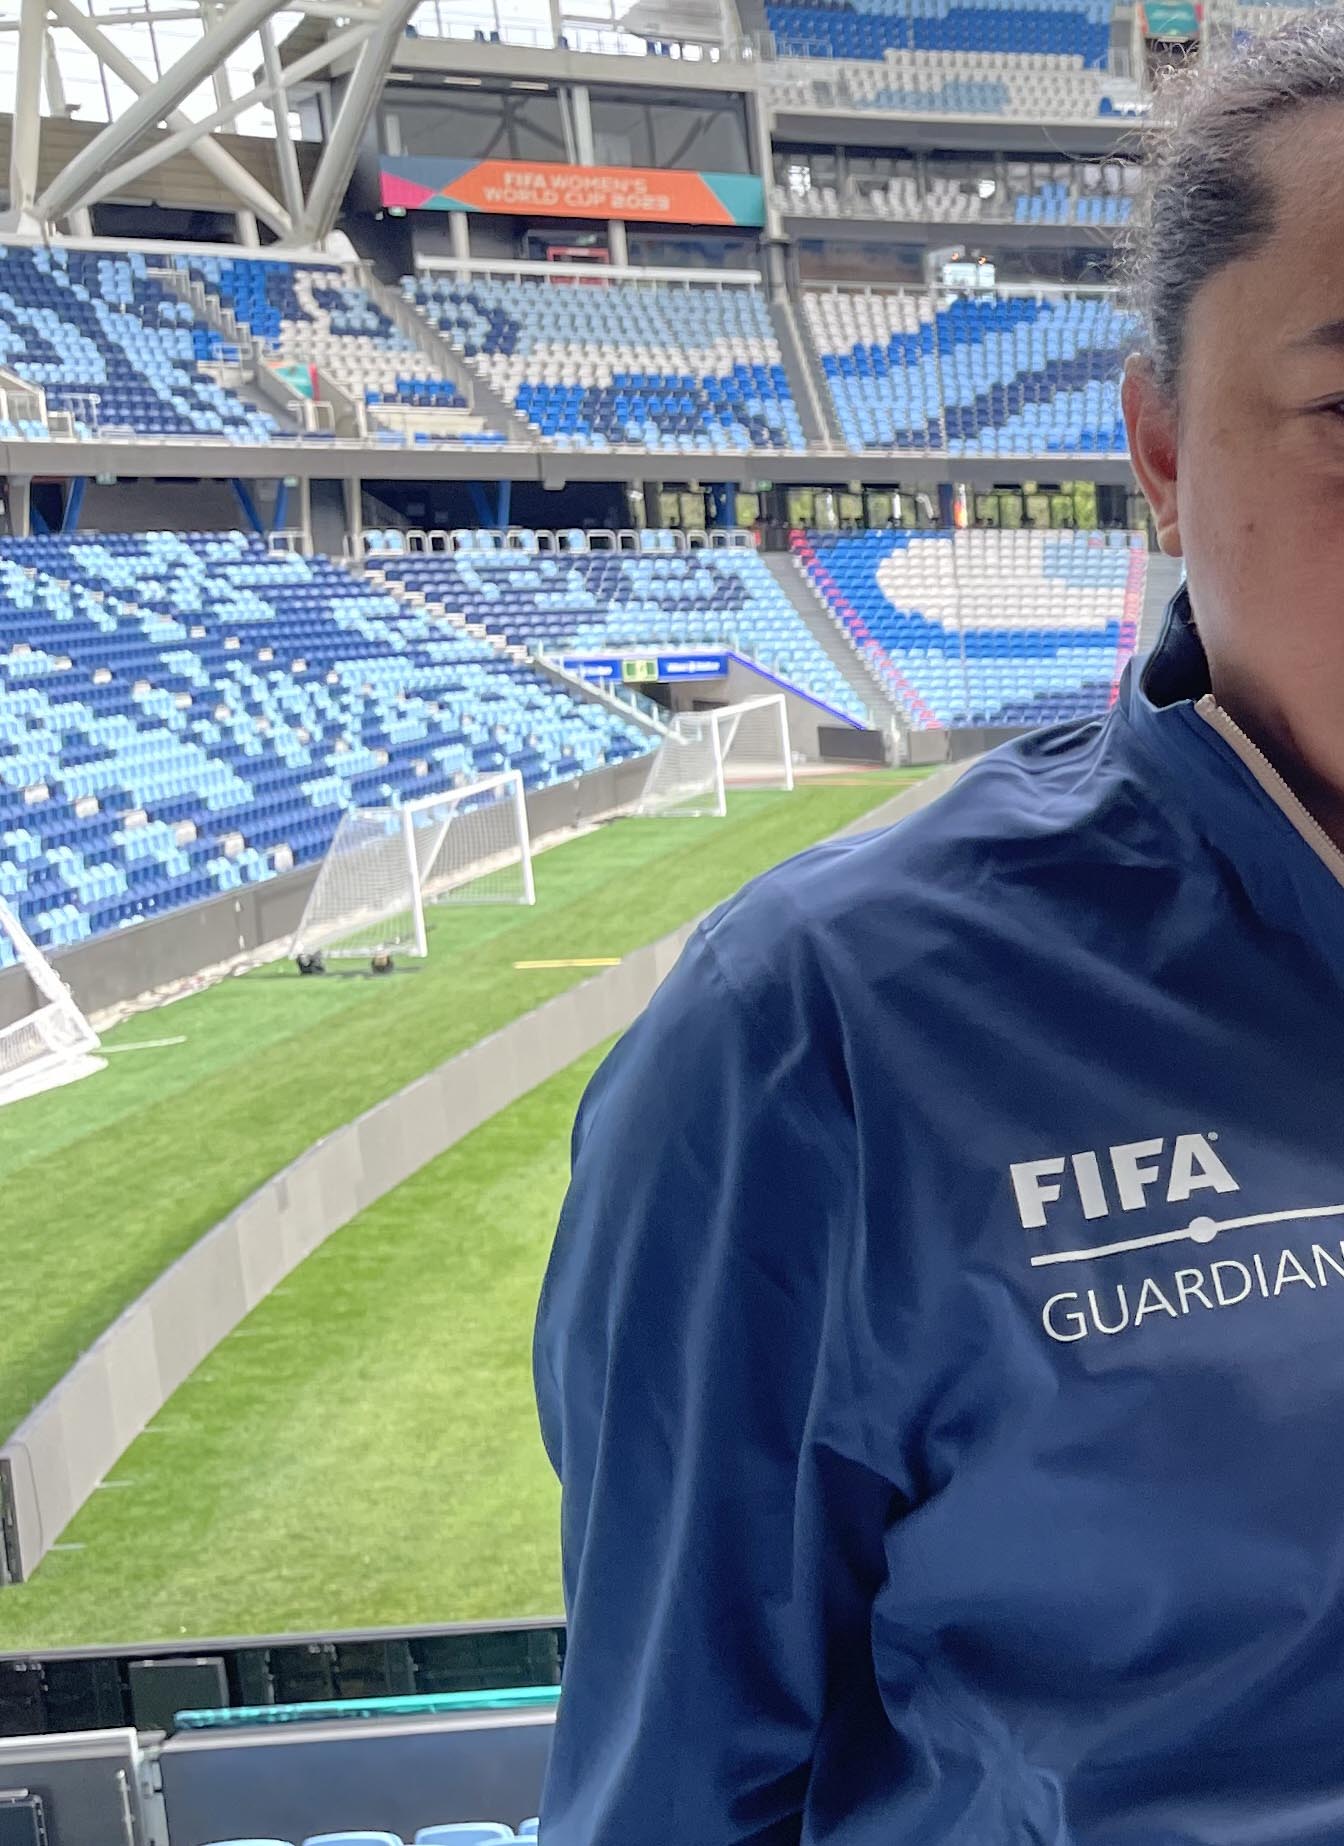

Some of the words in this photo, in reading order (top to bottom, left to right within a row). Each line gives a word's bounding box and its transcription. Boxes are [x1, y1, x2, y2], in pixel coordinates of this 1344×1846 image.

[503, 172, 547, 188] FIFA
[550, 174, 649, 194] WOMEN'S
[483, 187, 559, 206] WORLD
[564, 190, 607, 208] CUP
[1010, 1132, 1241, 1229] FIFA
